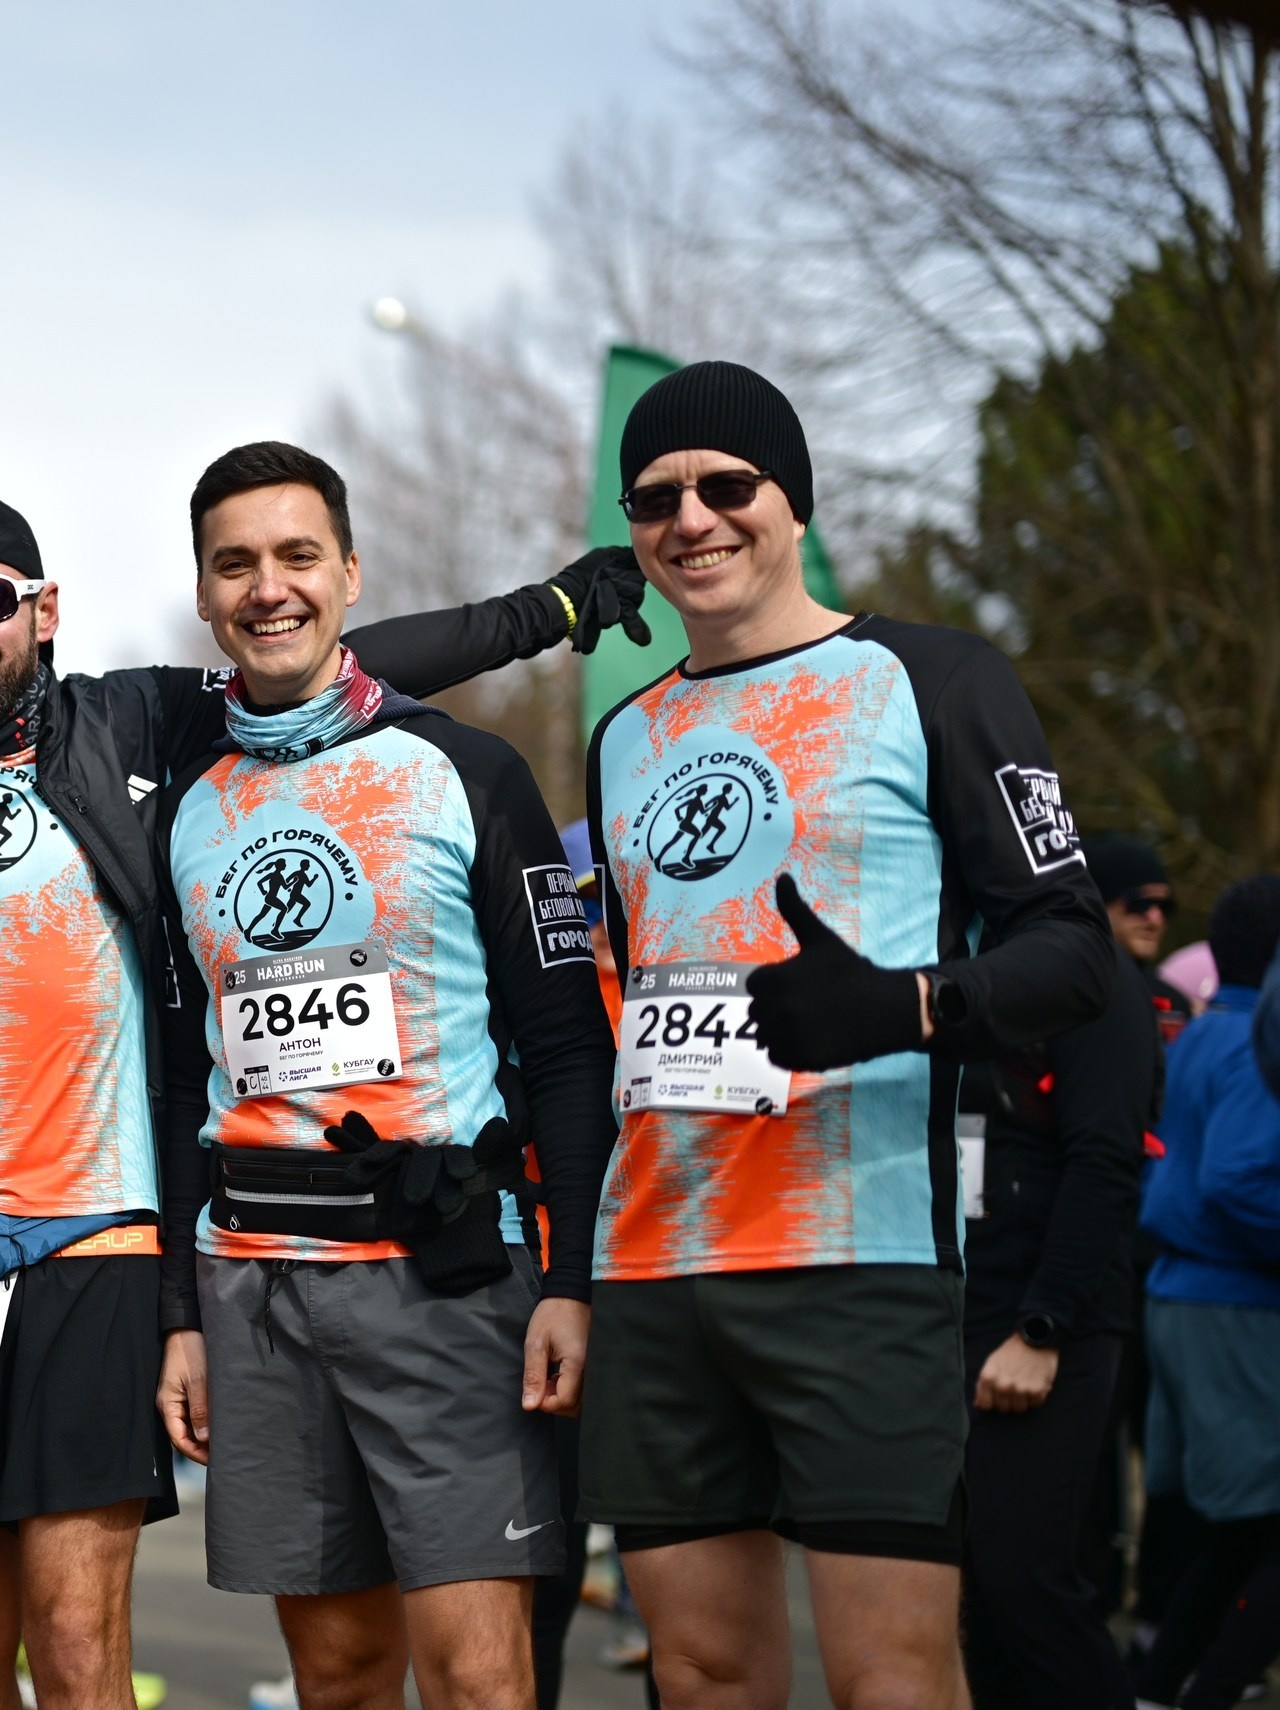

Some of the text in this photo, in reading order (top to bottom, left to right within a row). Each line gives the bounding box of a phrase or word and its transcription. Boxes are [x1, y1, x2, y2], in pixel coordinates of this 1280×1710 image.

[633, 752, 779, 828] БЕГ ПО ГОРЯЧЕМУ
[215, 829, 358, 898] БЕГ ПО ГОРЯЧЕМУ
[234, 970, 246, 984] 25
[257, 964, 293, 981] HARD
[294, 958, 325, 974] RUN
[640, 972, 738, 989] 25 HARD RUN
[238, 983, 370, 1041] 2846
[279, 1037, 322, 1052] АНТОН
[343, 1058, 375, 1069] КУБГАУ
[658, 1052, 723, 1067] ДМИТРИЙ
[289, 1066, 322, 1075] ВЫСШАЯ
[289, 1074, 308, 1082] ЛИГА
